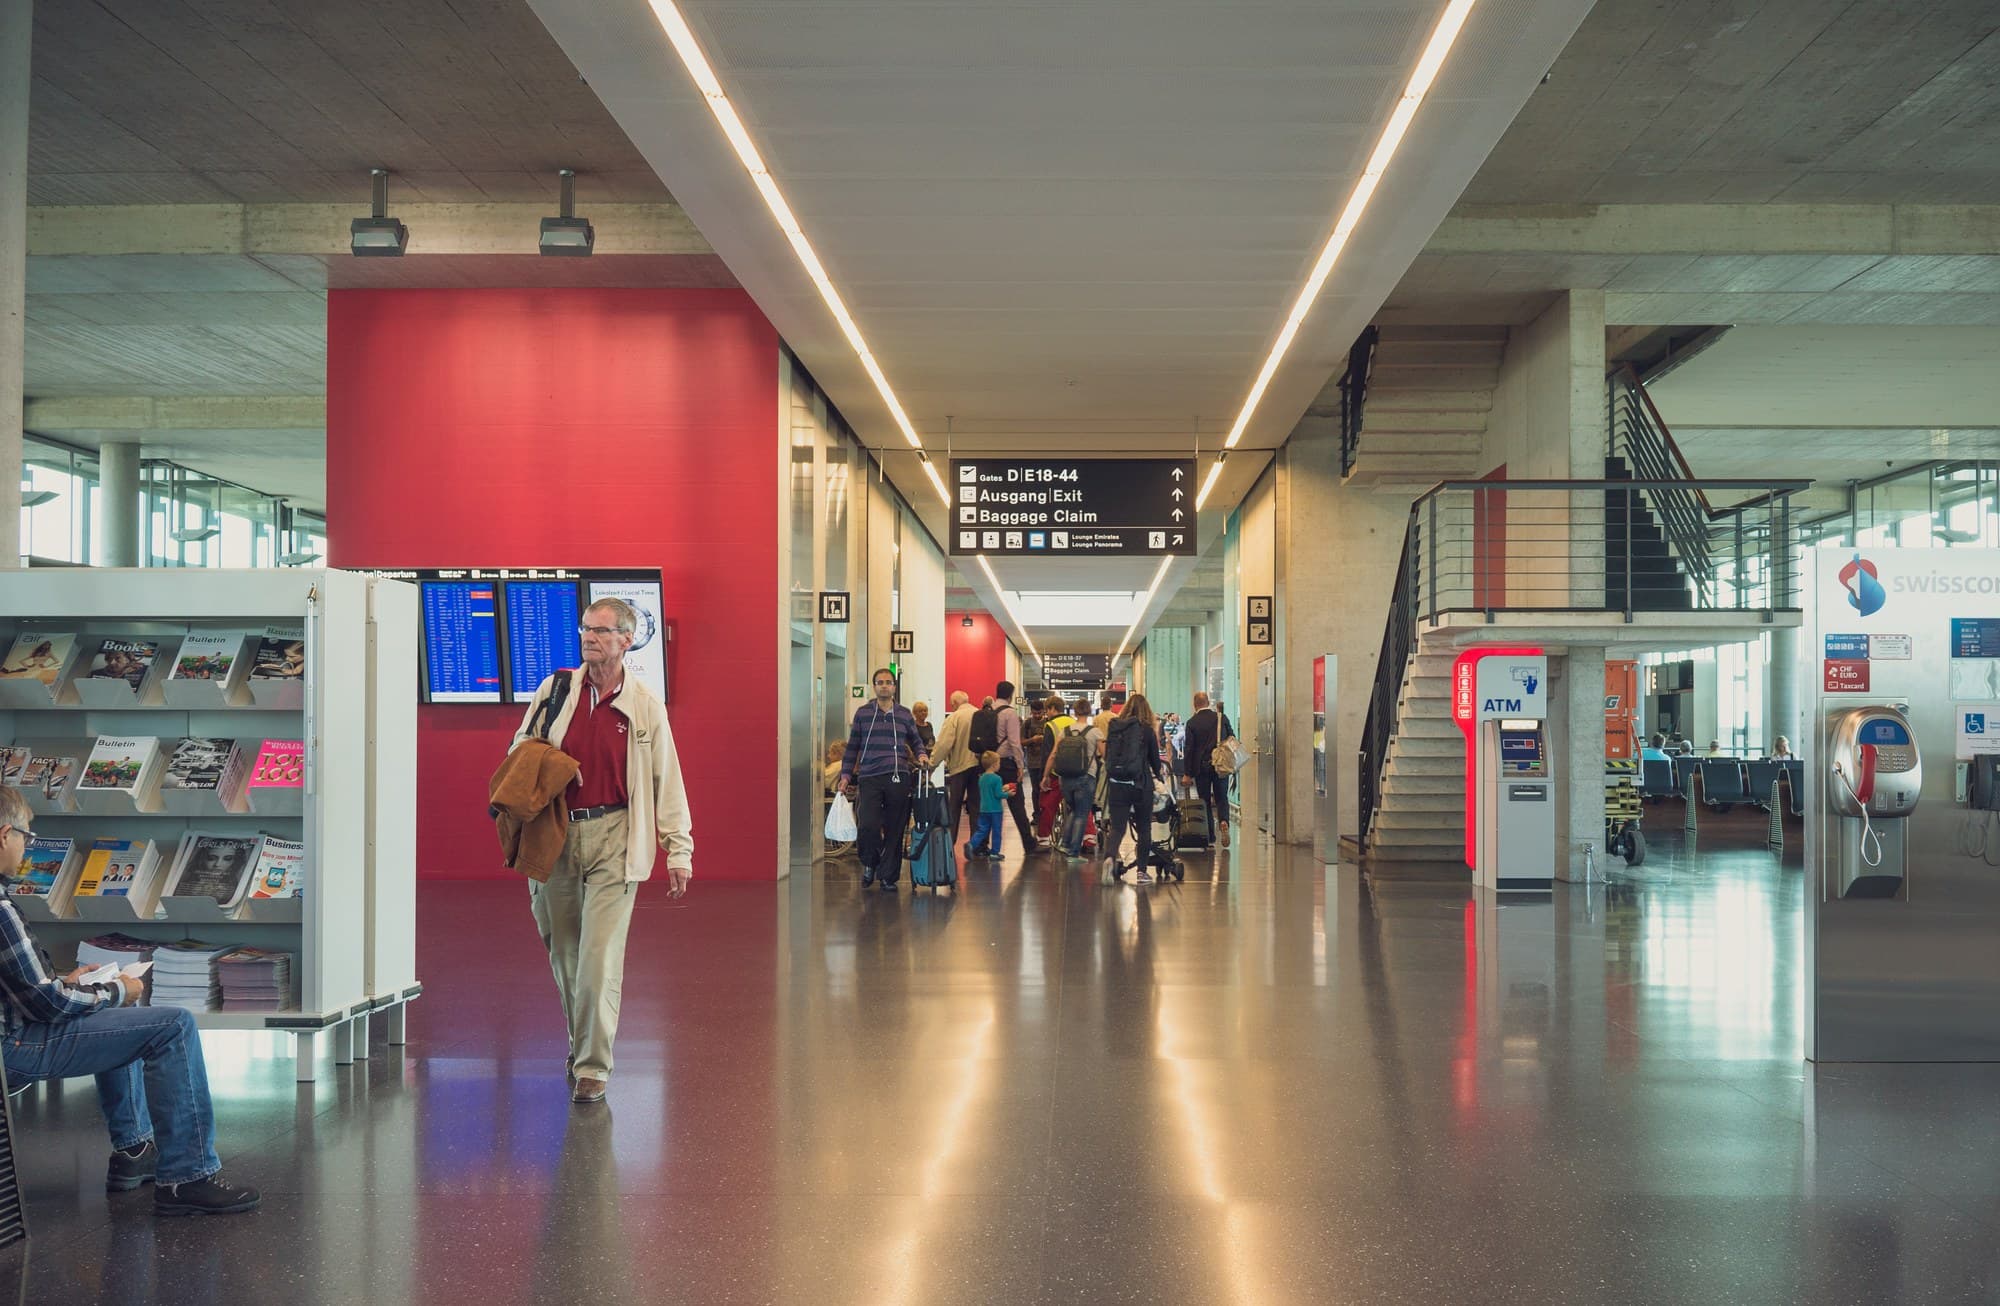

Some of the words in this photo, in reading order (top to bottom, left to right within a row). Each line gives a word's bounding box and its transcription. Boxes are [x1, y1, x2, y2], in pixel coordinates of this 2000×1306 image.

[980, 474, 1003, 482] Gates
[980, 510, 1048, 524] Baggage
[1053, 509, 1098, 523] Claim
[1483, 698, 1522, 713] ATM
[97, 739, 136, 748] Bulletin
[255, 767, 303, 782] 100
